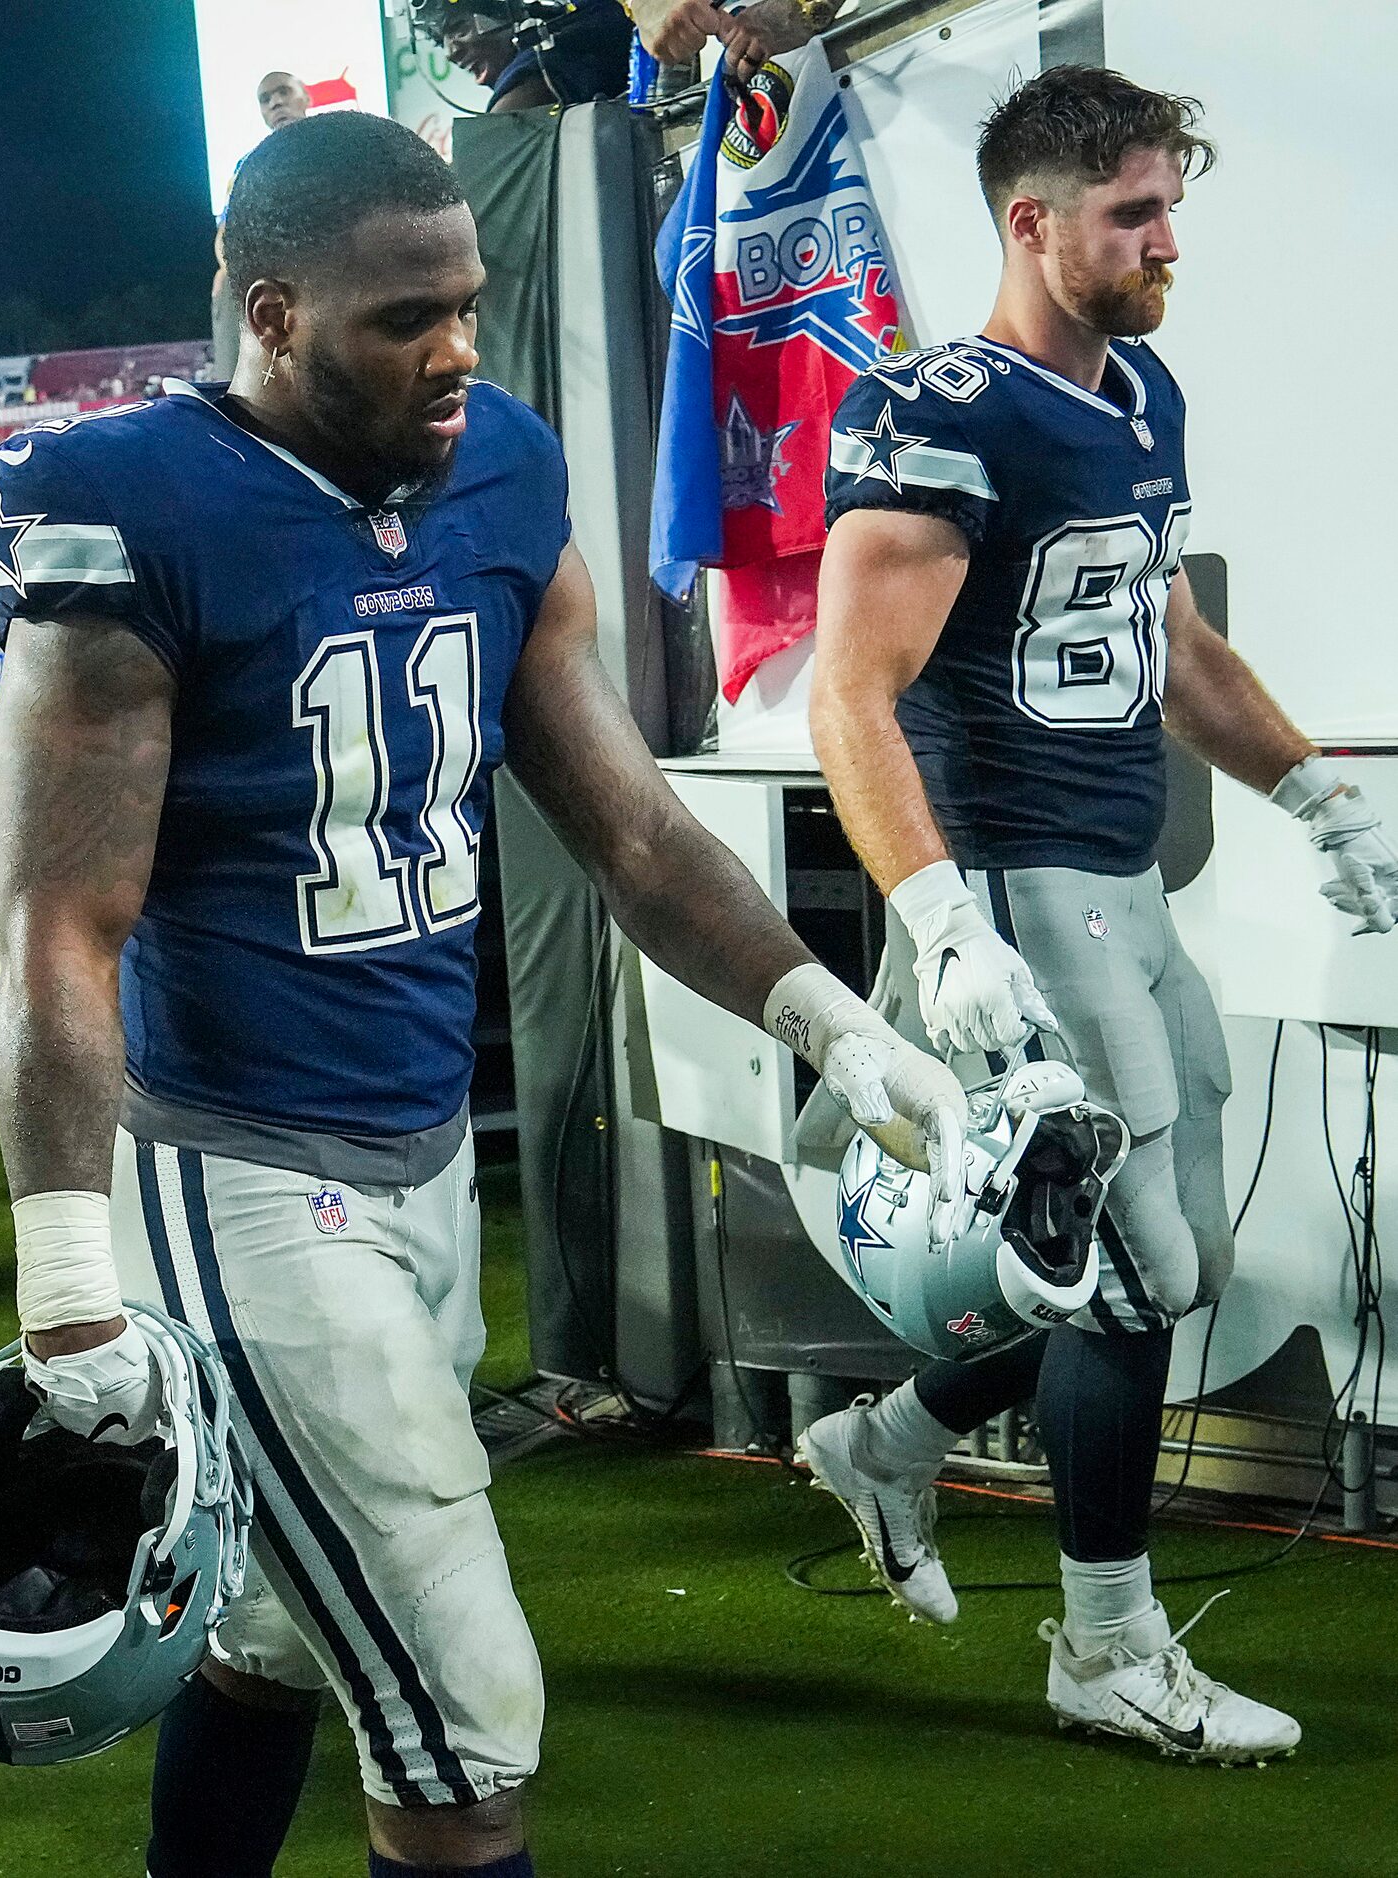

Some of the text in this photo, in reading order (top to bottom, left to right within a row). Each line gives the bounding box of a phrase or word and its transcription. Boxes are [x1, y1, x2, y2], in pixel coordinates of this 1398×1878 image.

[380, 528, 403, 547] NFL
[354, 586, 435, 617] COWBOYS
[292, 612, 482, 956] 11
[319, 1206, 346, 1228] NFL
